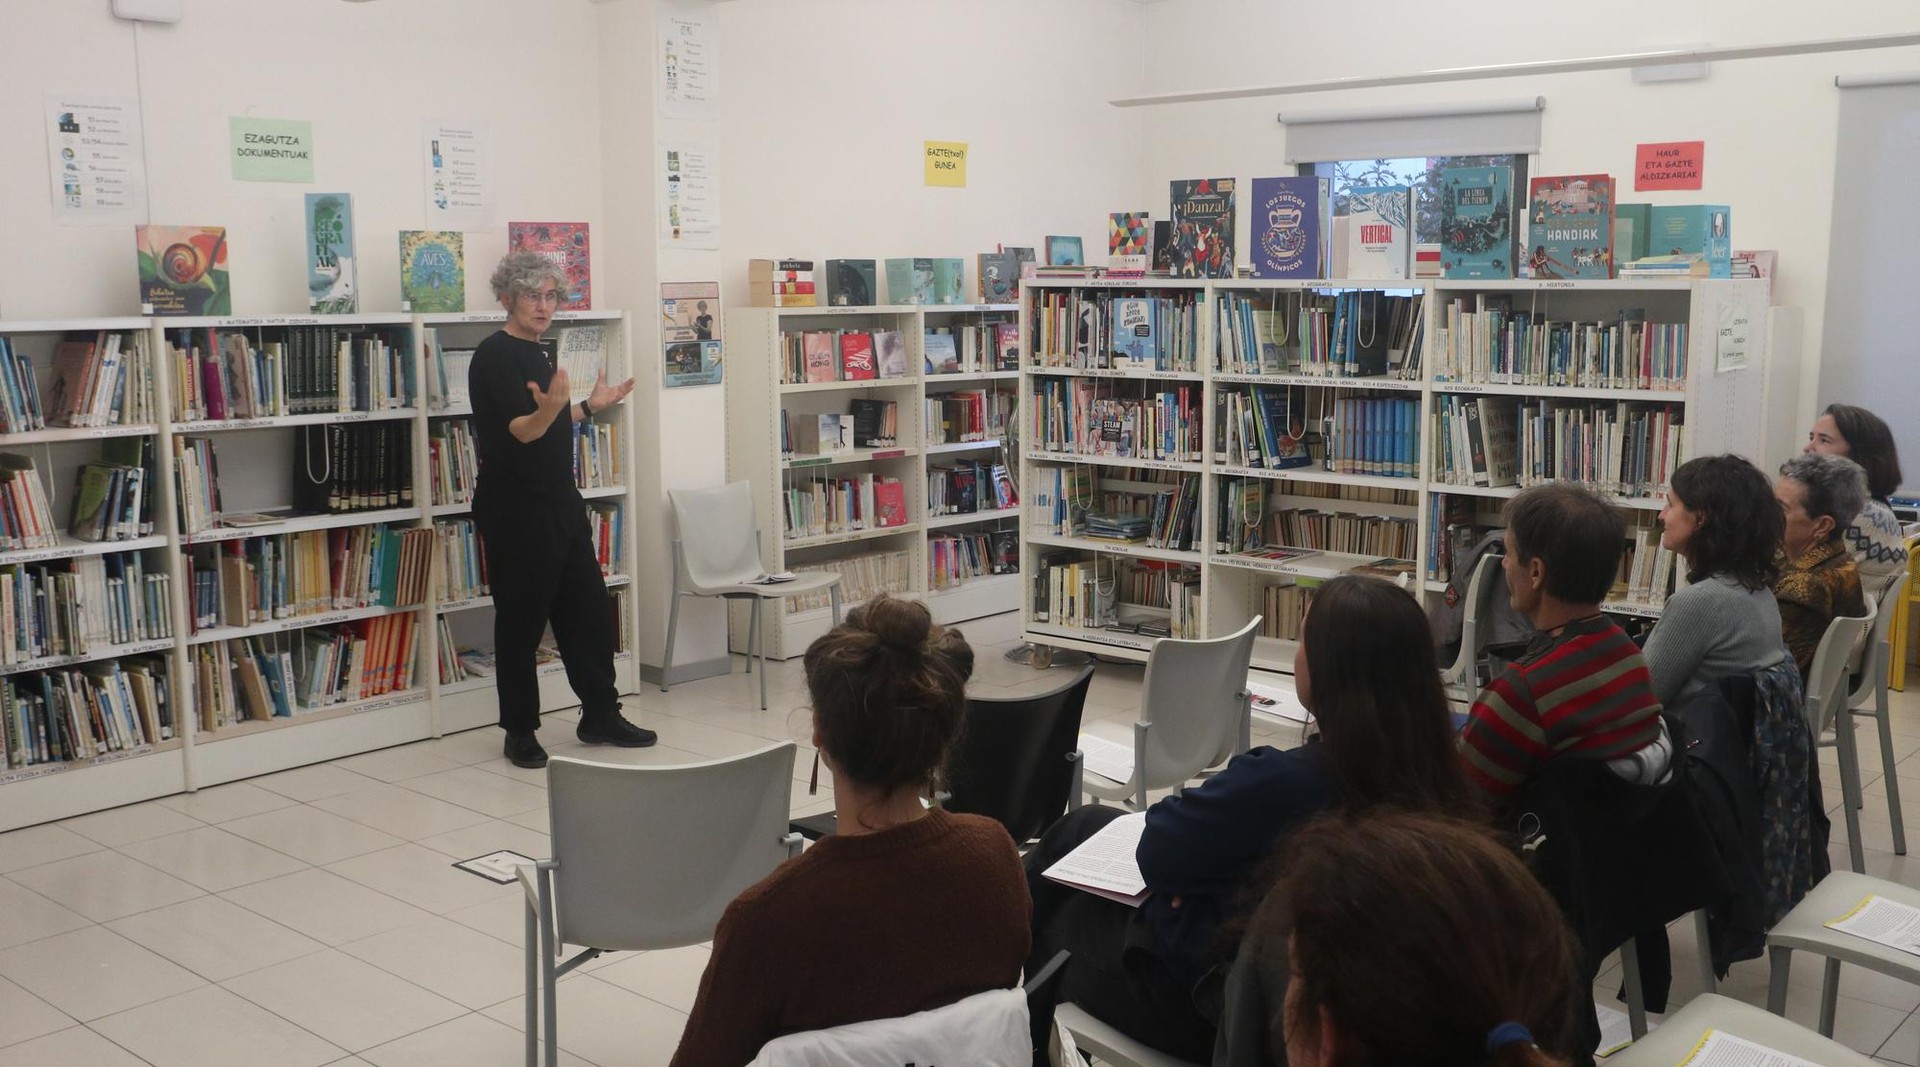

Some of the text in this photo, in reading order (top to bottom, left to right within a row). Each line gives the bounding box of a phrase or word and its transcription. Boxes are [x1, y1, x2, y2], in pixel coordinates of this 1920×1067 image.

[244, 133, 299, 145] EZAGUTZA
[237, 148, 308, 159] DOKUMENTUAK
[935, 161, 956, 170] GUNEA
[1645, 160, 1693, 169] ETA GAZTE
[1640, 171, 1698, 180] ALDIZKARIAK
[1265, 195, 1306, 209] LOS JUEGOS
[1183, 199, 1225, 217] ¡Danza!
[1360, 224, 1393, 244] VERTICAL
[1547, 229, 1598, 242] HANDIAK
[421, 253, 446, 267] AVES
[810, 359, 830, 368] KONG
[1103, 420, 1120, 429] STEAM
[1274, 564, 1299, 573] GEOGRAFIA
[1600, 603, 1611, 611] KAL
[1612, 605, 1638, 614] HERRIKO
[1117, 639, 1141, 647] LITERATURA
